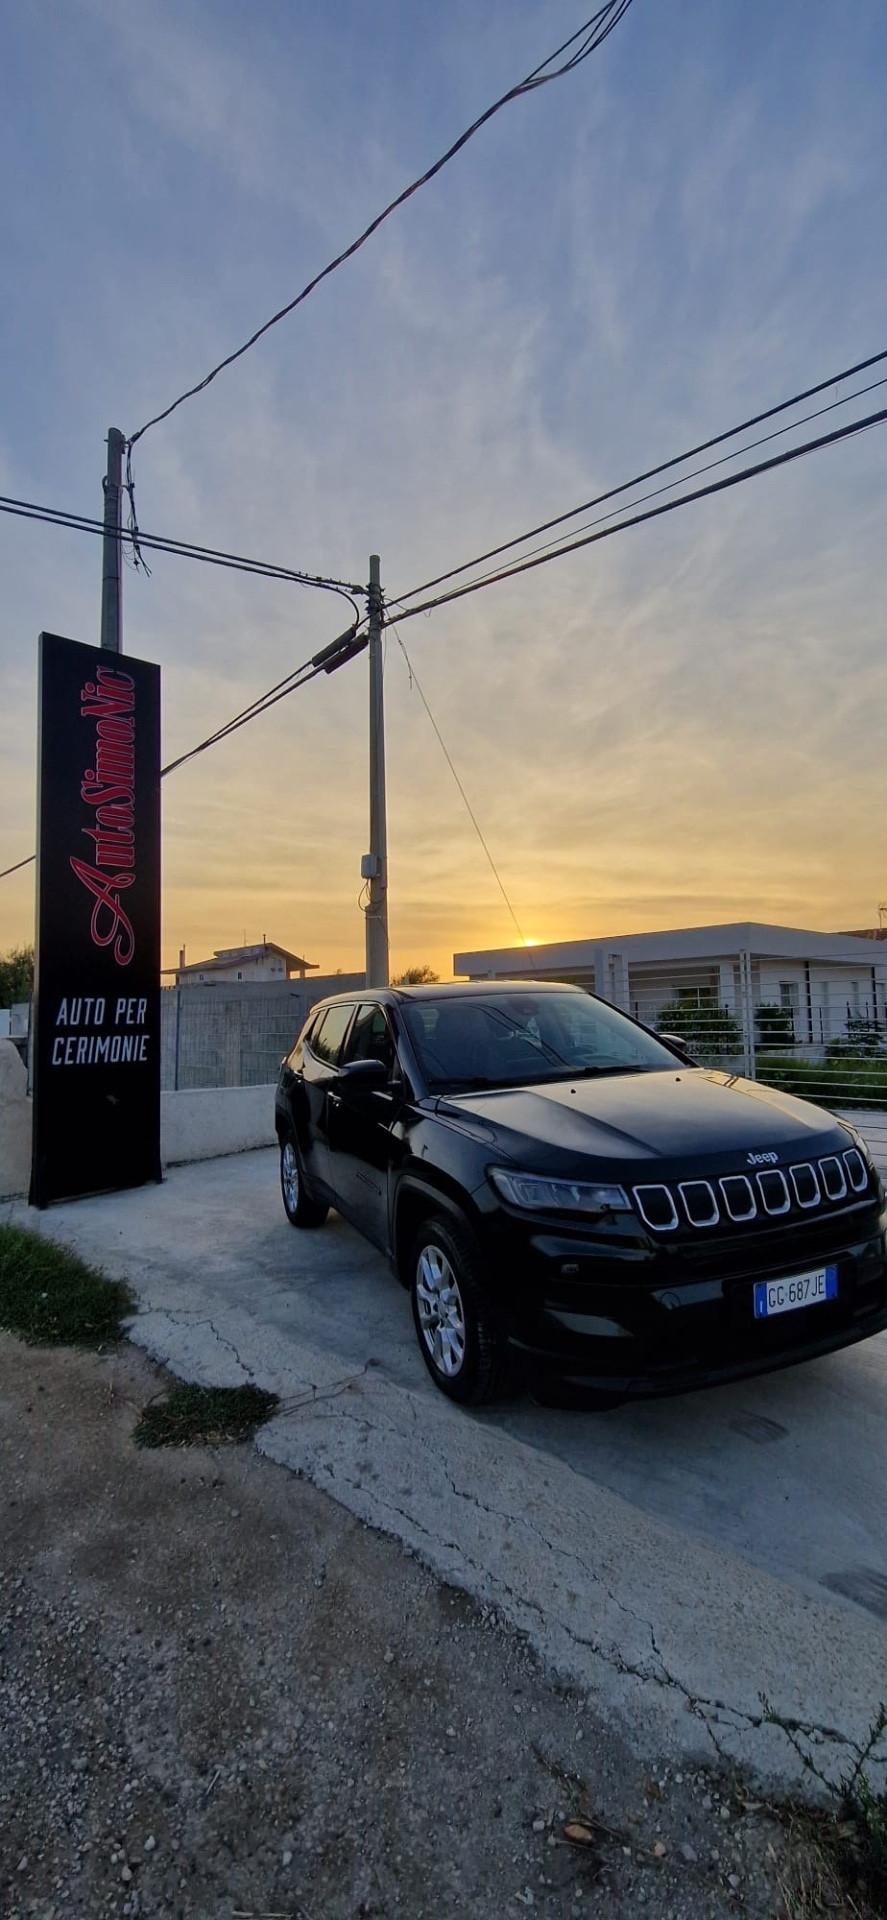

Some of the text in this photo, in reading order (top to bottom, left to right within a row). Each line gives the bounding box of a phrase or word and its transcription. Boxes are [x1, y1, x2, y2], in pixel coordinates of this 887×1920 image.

[69, 665, 136, 966] AutoSimoNic
[56, 997, 147, 1026] AUTO PER
[52, 1035, 150, 1066] CERIMONIE
[747, 1152, 779, 1165] Jeep
